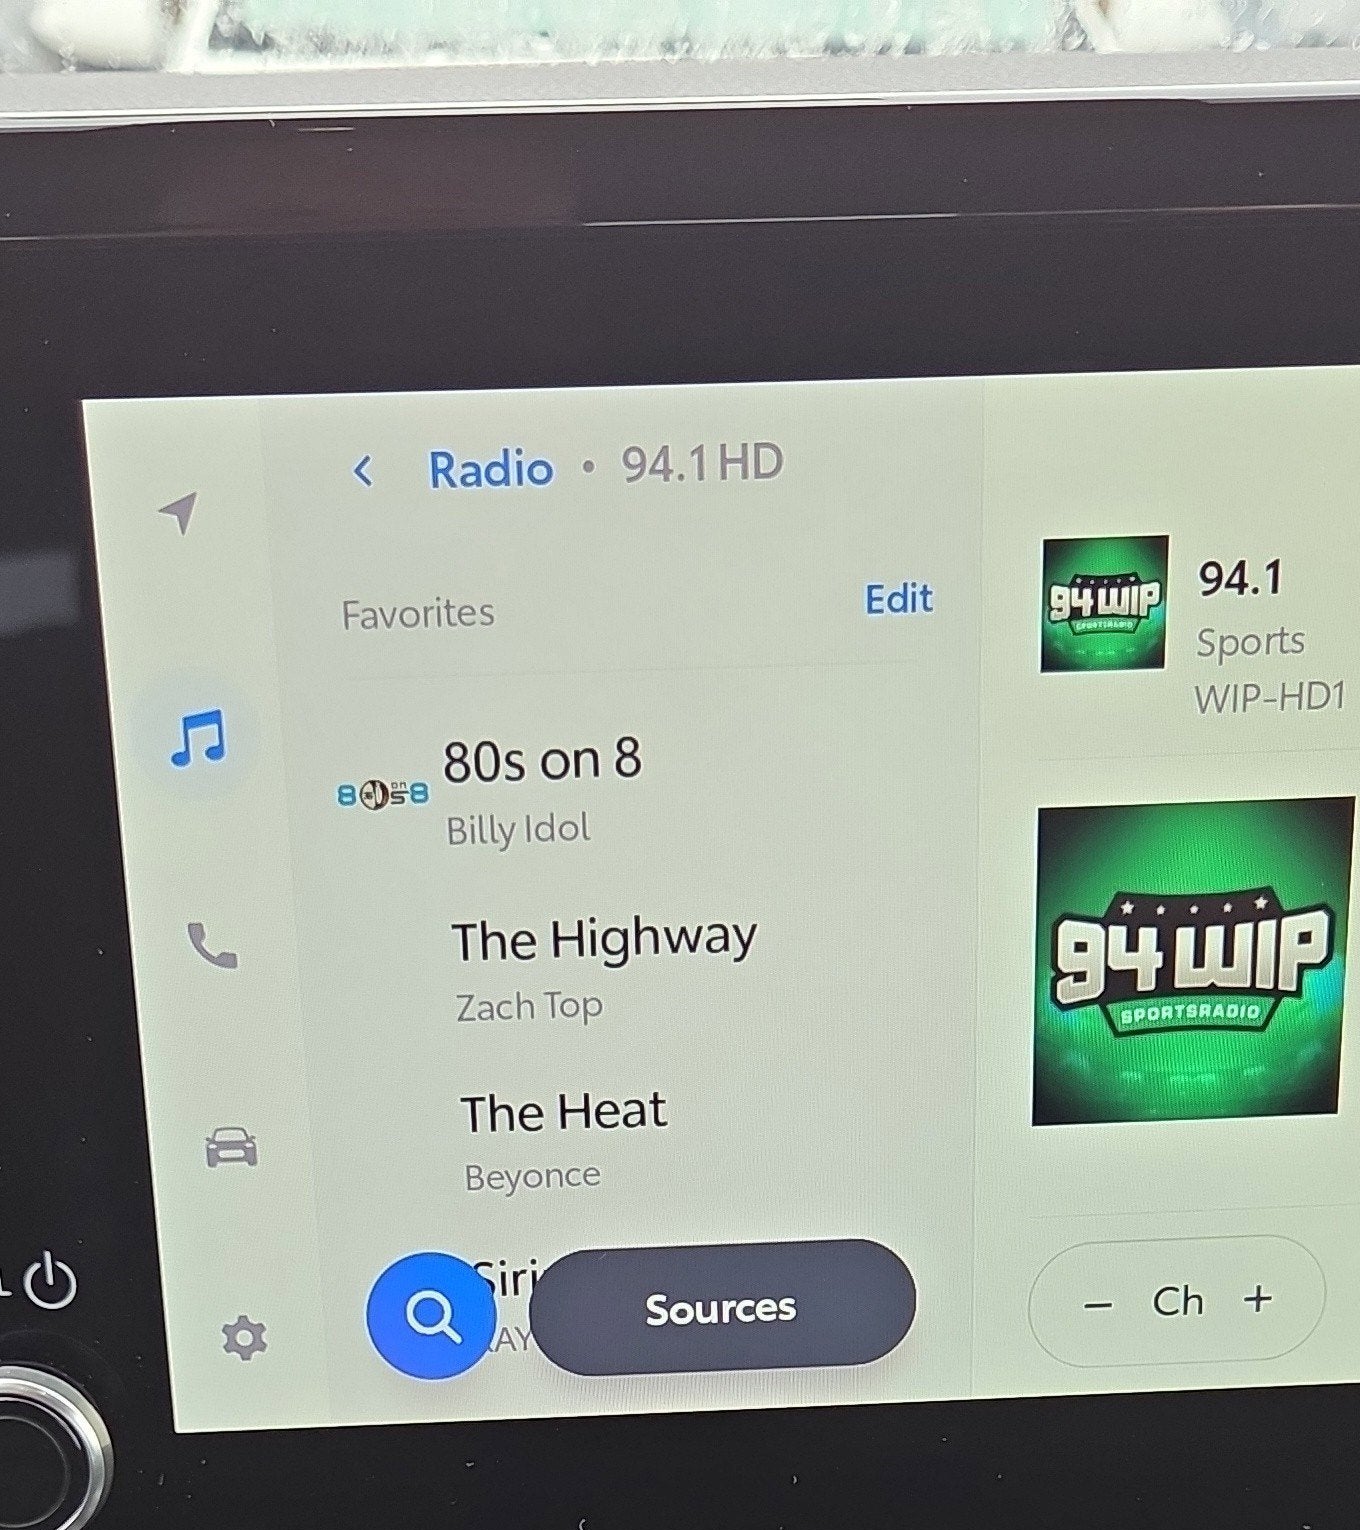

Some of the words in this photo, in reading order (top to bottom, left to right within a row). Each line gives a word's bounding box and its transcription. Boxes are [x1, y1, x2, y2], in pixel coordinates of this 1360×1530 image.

[430, 447, 554, 489] Radio
[1199, 558, 1280, 597] 94.1
[342, 595, 495, 630] Favorites
[866, 581, 933, 615] Edit
[1049, 584, 1094, 621] 94
[1097, 581, 1160, 617] WIP
[1197, 626, 1305, 666] Sports
[1194, 680, 1344, 714] WIP-HD1
[444, 740, 526, 784] 80s
[540, 747, 600, 781] on
[615, 736, 642, 778] 8
[447, 813, 516, 853] Billy
[525, 810, 591, 843] Idol
[451, 920, 537, 961] The
[552, 914, 758, 969] Highway
[1056, 919, 1164, 1005] 94
[1173, 910, 1330, 991] WIP
[456, 991, 535, 1022] Zach
[543, 990, 603, 1026] Top
[1121, 1003, 1261, 1025] SPORTSRADIO
[460, 1093, 544, 1133] The
[559, 1091, 668, 1130] Heat
[465, 1164, 601, 1198] Beyonce
[646, 1294, 797, 1326] Sources
[1153, 1284, 1203, 1317] Ch
[489, 1326, 532, 1352] AY
